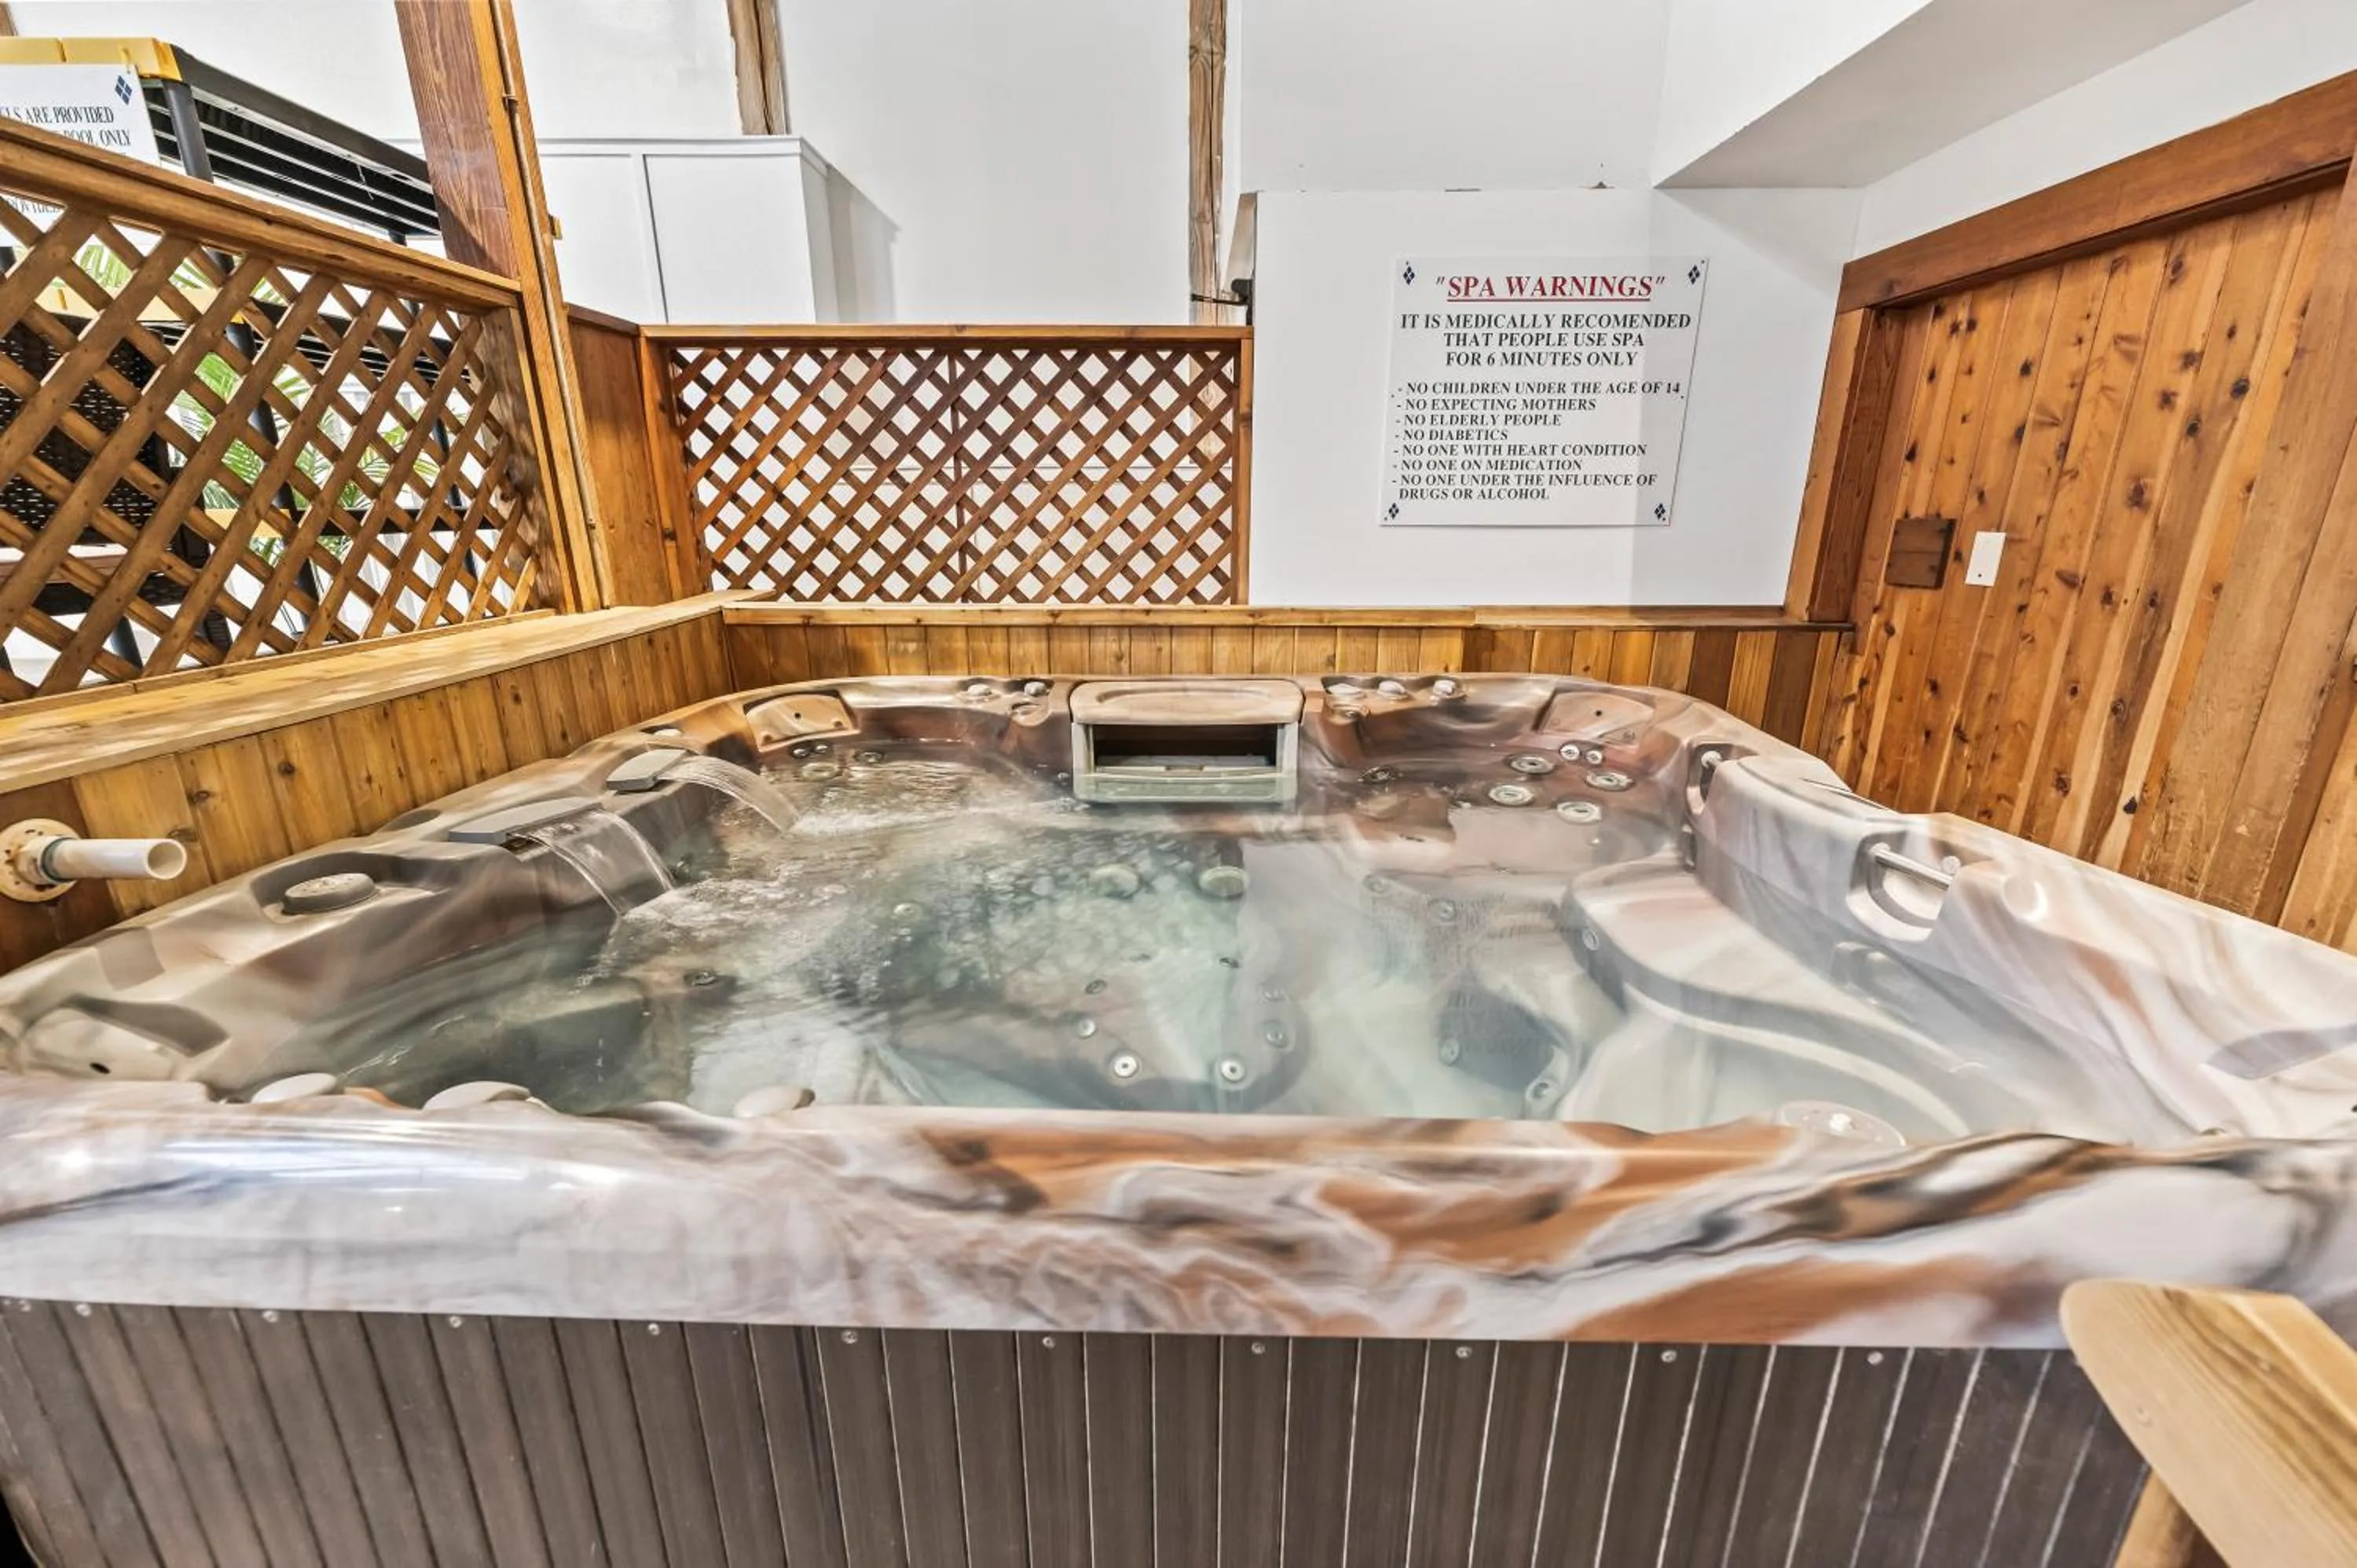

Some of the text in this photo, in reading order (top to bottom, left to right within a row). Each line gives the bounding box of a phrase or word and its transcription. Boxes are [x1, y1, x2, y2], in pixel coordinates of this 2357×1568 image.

[25, 106, 52, 123] ARE
[53, 105, 115, 123] PROVIDED
[99, 128, 131, 147] ONLY
[1401, 313, 1692, 329] IT IS MEDICALLY RECOMENDED
[1443, 332, 1645, 347] THAT PEOPLE USE SPA
[1446, 351, 1639, 367] FOR 6 MINUTES ONLY
[1406, 382, 1428, 394] NO
[1431, 382, 1511, 394] CHILDREN
[1515, 382, 1567, 394] UNDER
[1571, 382, 1602, 394] THE
[1605, 382, 1637, 394] AGE
[1640, 382, 1663, 394] OF
[1666, 382, 1681, 394] 14
[1405, 398, 1428, 411] NO
[1431, 398, 1517, 411] EXPECTING
[1520, 398, 1597, 411] MOTHERS
[1404, 414, 1426, 427] NO
[1430, 414, 1501, 427] ELDERLY
[1504, 414, 1562, 427] PEOPLE
[1402, 429, 1425, 441] NO
[1428, 429, 1508, 441] DIABETICS
[1402, 444, 1424, 456] NO
[1428, 444, 1459, 456] ONE
[1463, 444, 1502, 456] WITH
[1506, 444, 1560, 456] HEART
[1561, 444, 1648, 456] CONDITION
[1401, 460, 1423, 471] NO
[1426, 460, 1457, 471] ONE
[1461, 460, 1483, 471] ON
[1486, 460, 1583, 471] MEDICATION
[1400, 474, 1422, 486] NO
[1425, 474, 1457, 486] ONE
[1460, 474, 1512, 486] UNDER
[1514, 474, 1545, 486] THE
[1547, 474, 1633, 486] INFLUENCE
[1636, 474, 1659, 486] OF
[1398, 488, 1549, 500] DRUGS OR ALCOHOL
